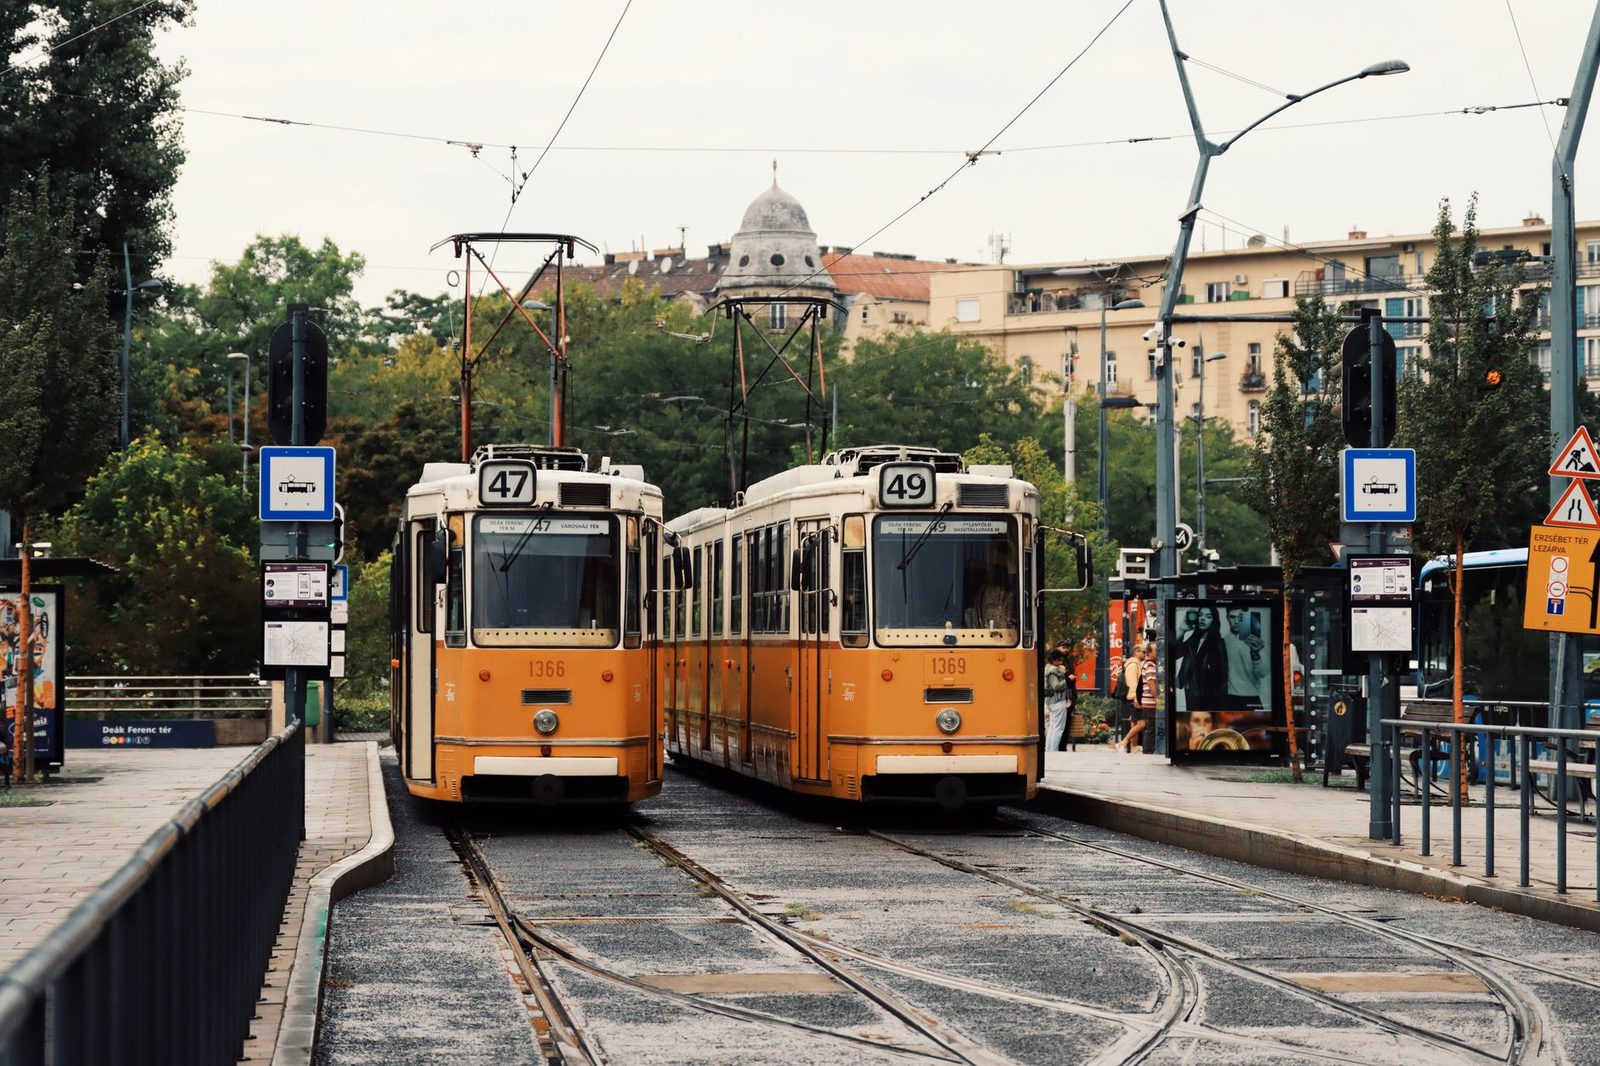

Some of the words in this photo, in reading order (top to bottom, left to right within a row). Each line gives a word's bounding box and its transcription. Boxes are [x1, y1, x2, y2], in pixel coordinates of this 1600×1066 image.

[488, 470, 529, 498] 47
[886, 473, 927, 500] 49
[534, 520, 551, 532] 47
[929, 521, 947, 533] 49
[1534, 533, 1573, 544] ERZSÉBET
[1574, 536, 1589, 545] TÉR
[1533, 544, 1567, 554] LEZÁRVA
[528, 660, 566, 678] 1366
[931, 657, 967, 675] 1369
[102, 725, 125, 734] Deák
[127, 725, 157, 734] Ferenc
[158, 725, 172, 734] tér
